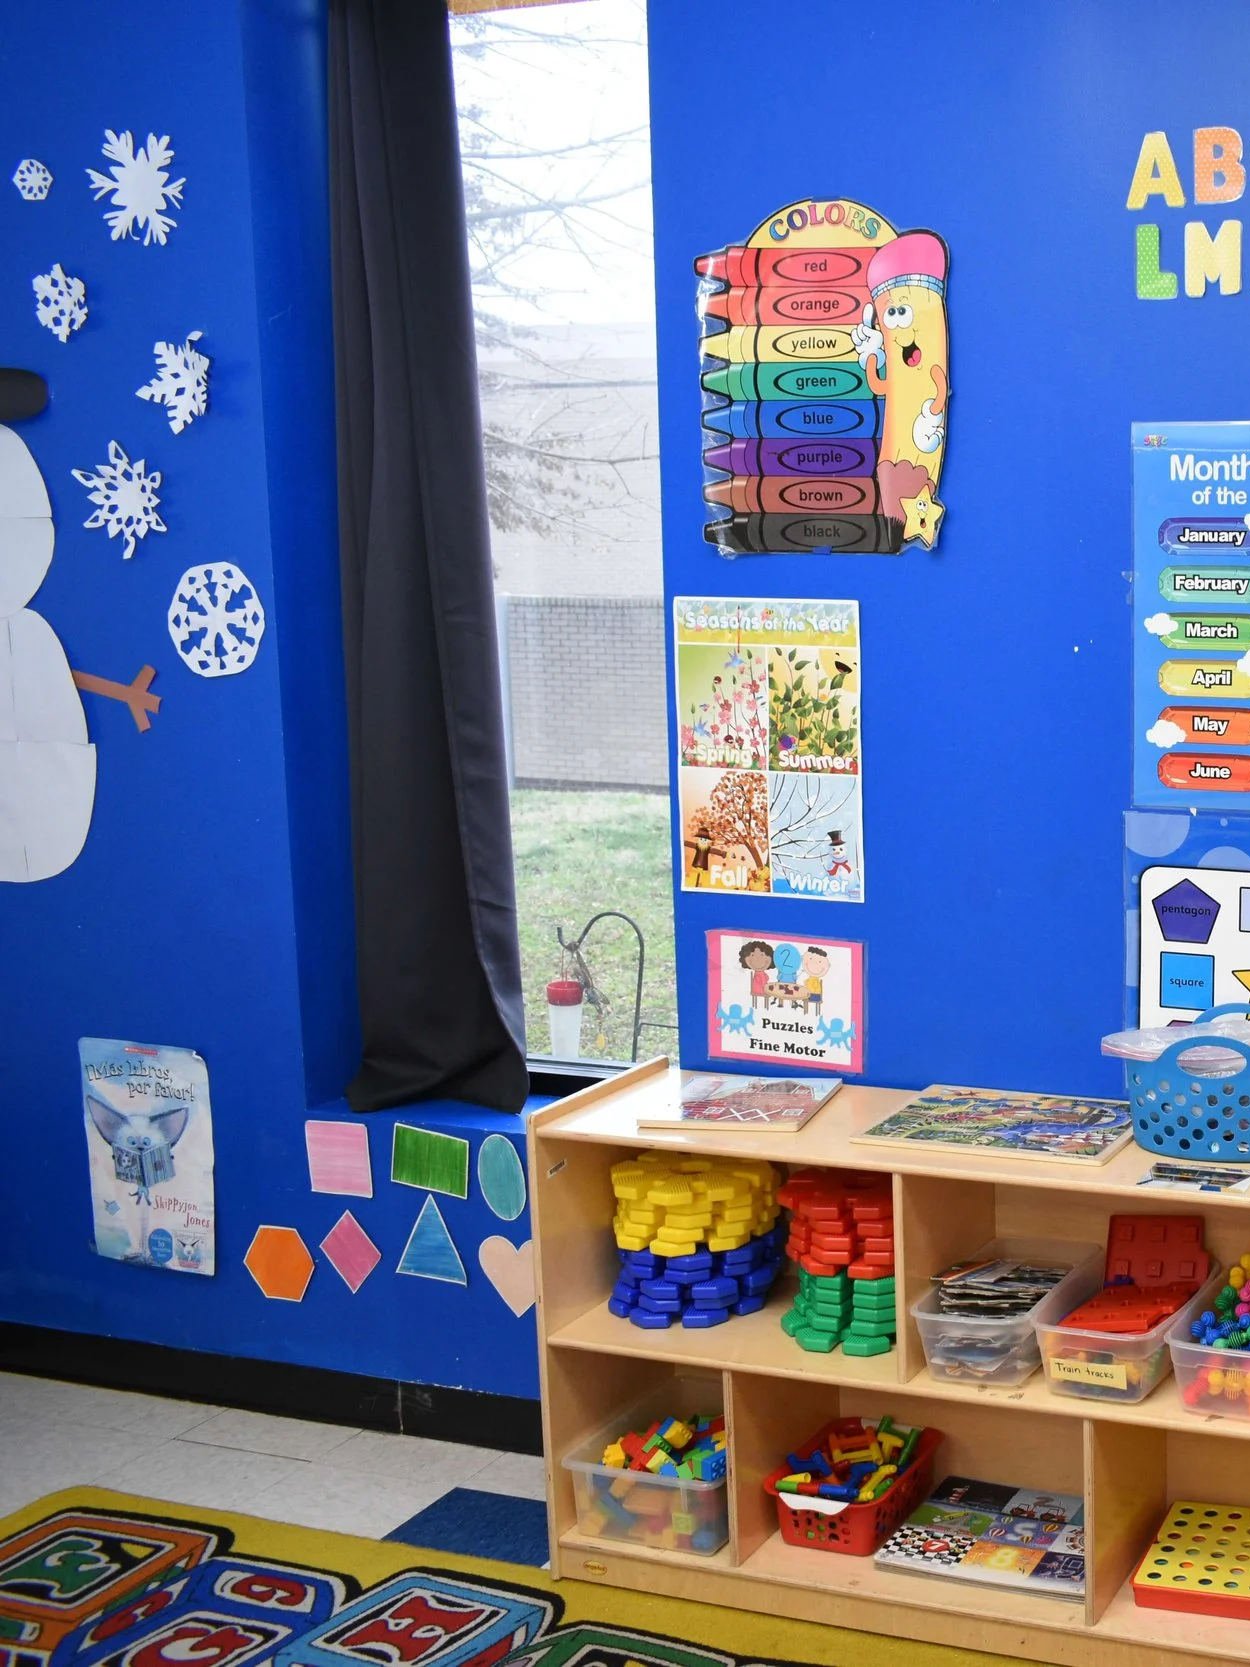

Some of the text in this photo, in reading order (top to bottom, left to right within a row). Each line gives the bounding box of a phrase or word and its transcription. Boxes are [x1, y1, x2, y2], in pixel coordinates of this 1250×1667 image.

[768, 203, 881, 243] COLORS
[804, 260, 827, 273] red
[790, 298, 839, 312] orange
[791, 337, 837, 351] yellow
[796, 375, 837, 389] green
[803, 412, 833, 425] blue
[797, 450, 843, 465] purple
[799, 489, 843, 502] brown
[1191, 486, 1247, 505] of the
[803, 525, 841, 538] black
[1178, 527, 1247, 547] January
[1173, 575, 1250, 594] February
[684, 612, 849, 634] Seasons of the Year
[1185, 623, 1238, 639] March
[1192, 670, 1232, 688] April
[1192, 716, 1229, 735] May
[695, 745, 753, 769] Spring
[778, 749, 853, 770] Summer
[1189, 763, 1231, 779] June
[710, 865, 748, 889] Fall
[789, 872, 849, 893] Winter
[1161, 904, 1211, 918] pentagon
[1169, 976, 1204, 988] square
[761, 1018, 814, 1034] Puzzles
[749, 1039, 826, 1057] Fine Motor
[127, 1082, 151, 1098] por
[184, 1212, 210, 1228] Jones
[1055, 1362, 1114, 1379] Train tracks
[928, 1541, 945, 1551] 7
[990, 1548, 1018, 1568] 8
